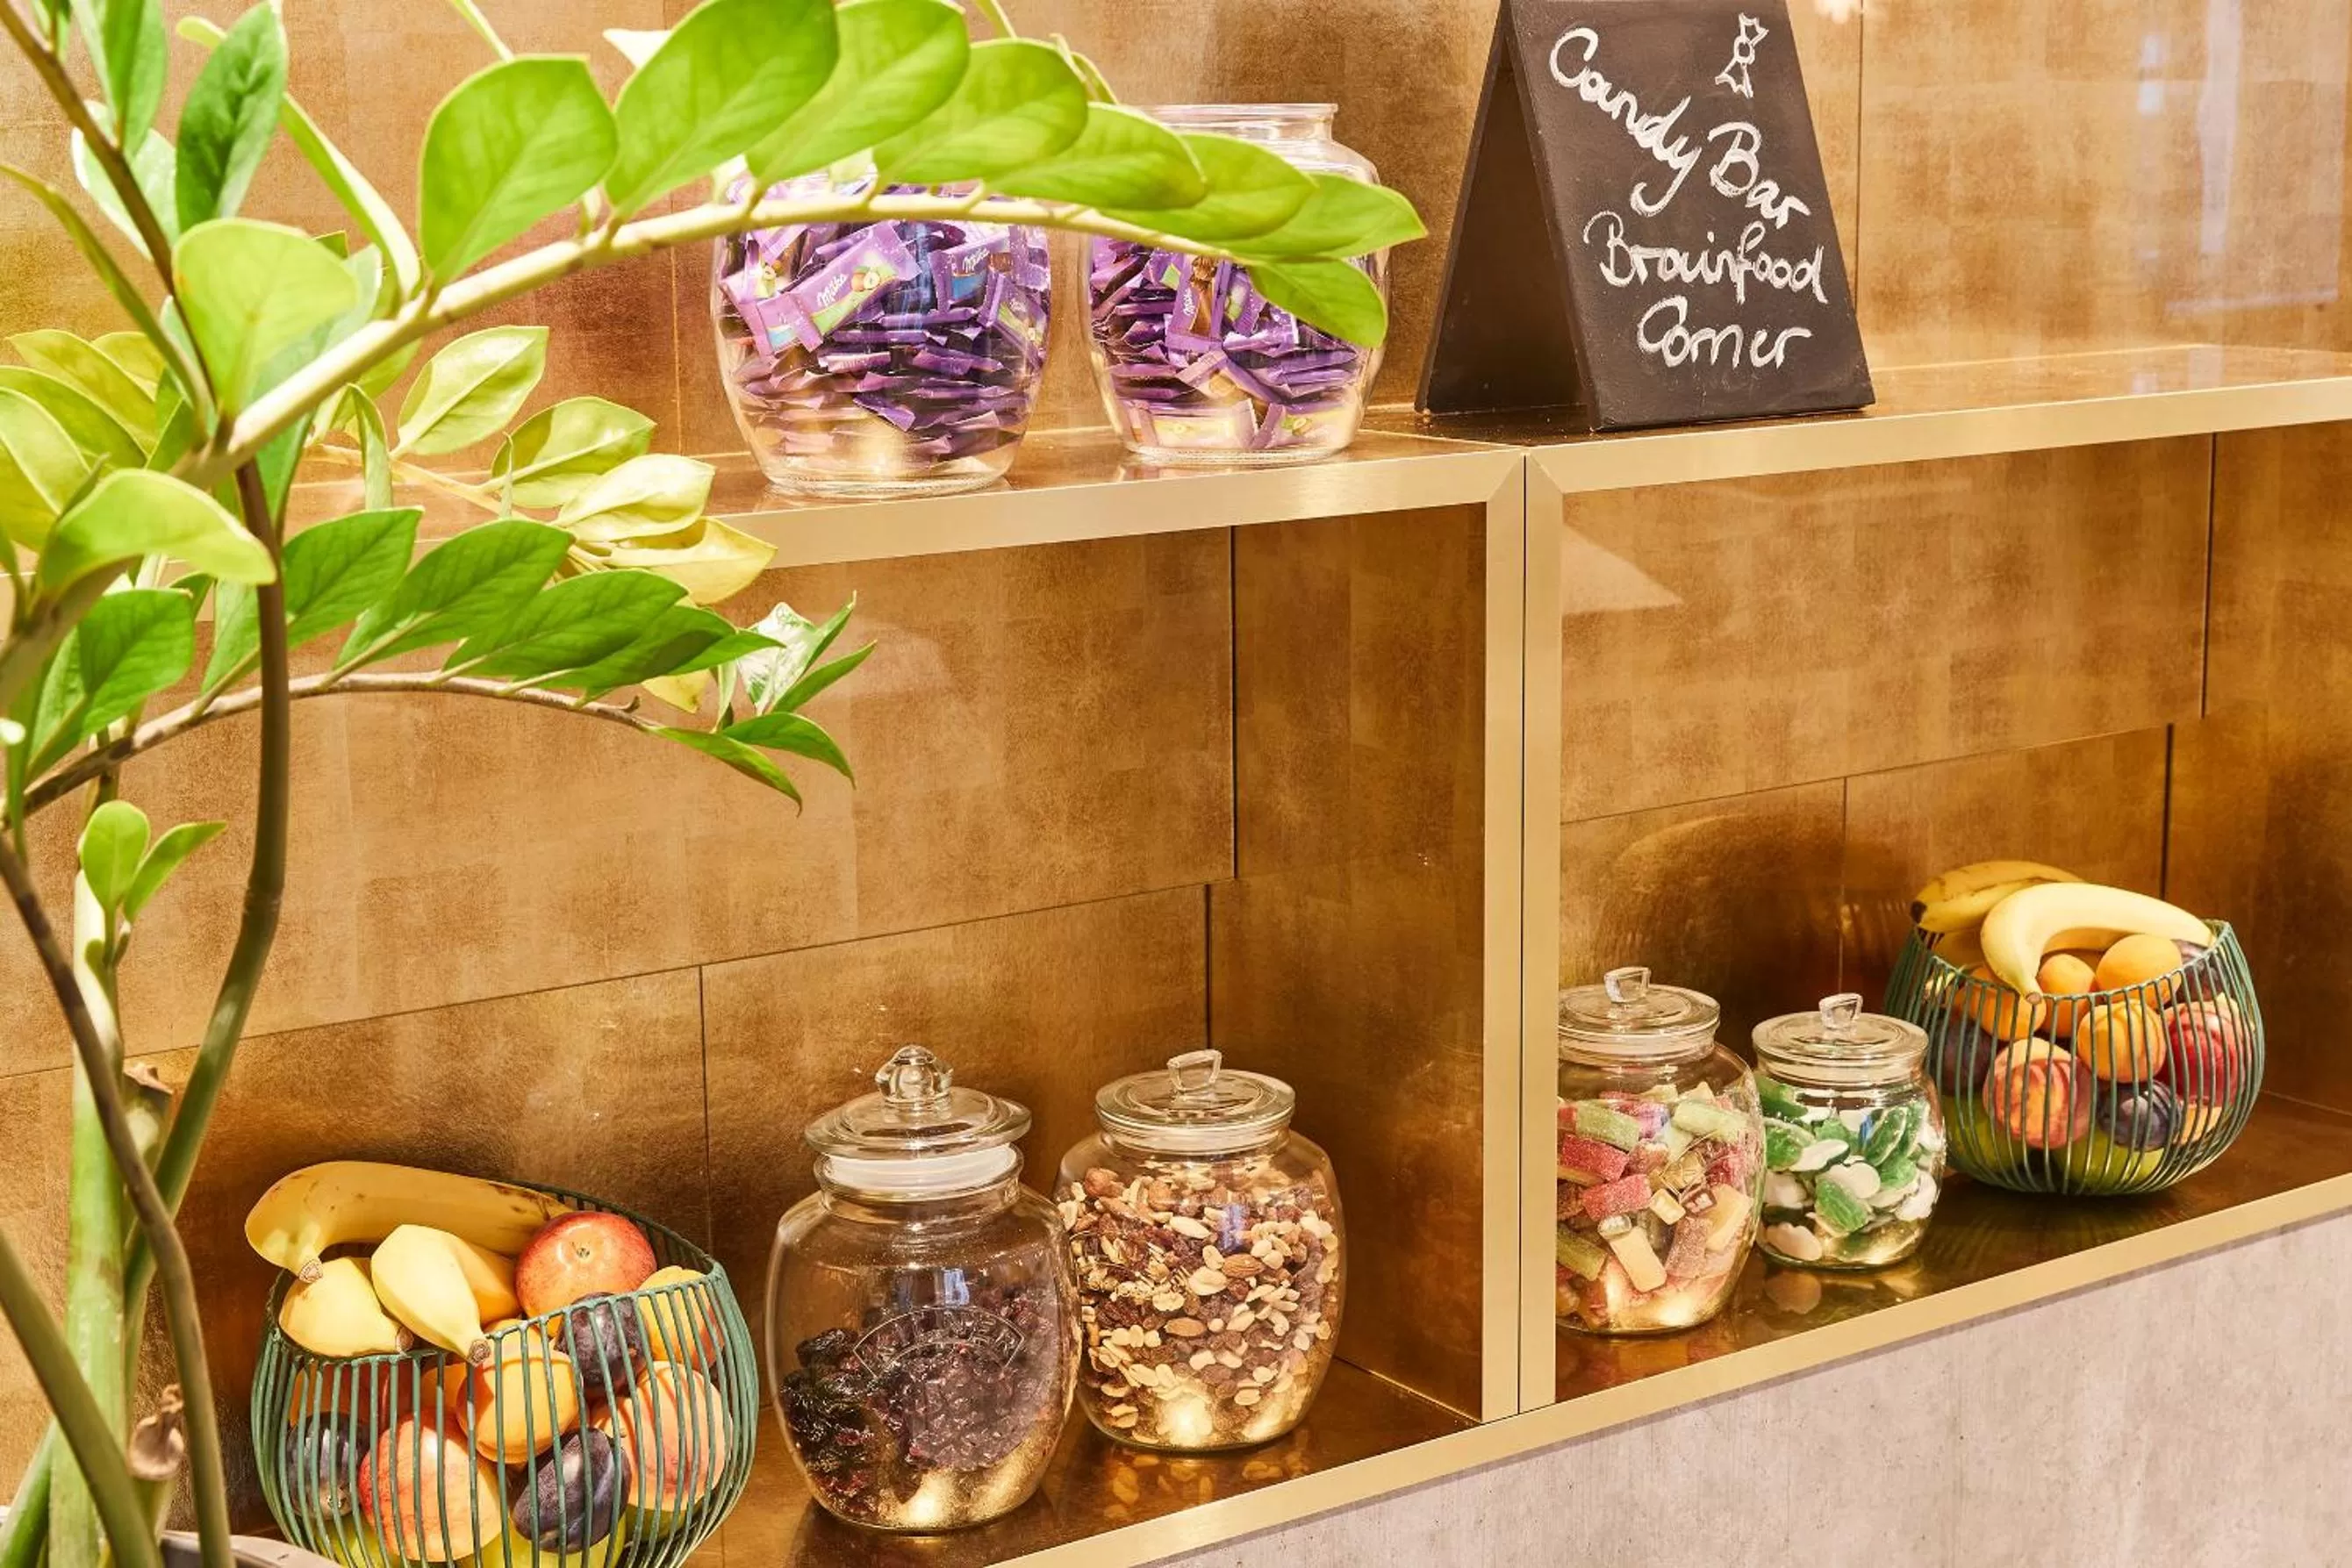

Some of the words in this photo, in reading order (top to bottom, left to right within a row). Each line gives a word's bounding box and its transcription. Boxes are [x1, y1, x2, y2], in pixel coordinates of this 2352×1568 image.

[1549, 27, 1702, 217] Candy
[1708, 121, 1811, 229] Bar
[1583, 211, 1828, 304] Brainfood
[1637, 296, 1812, 369] Corner
